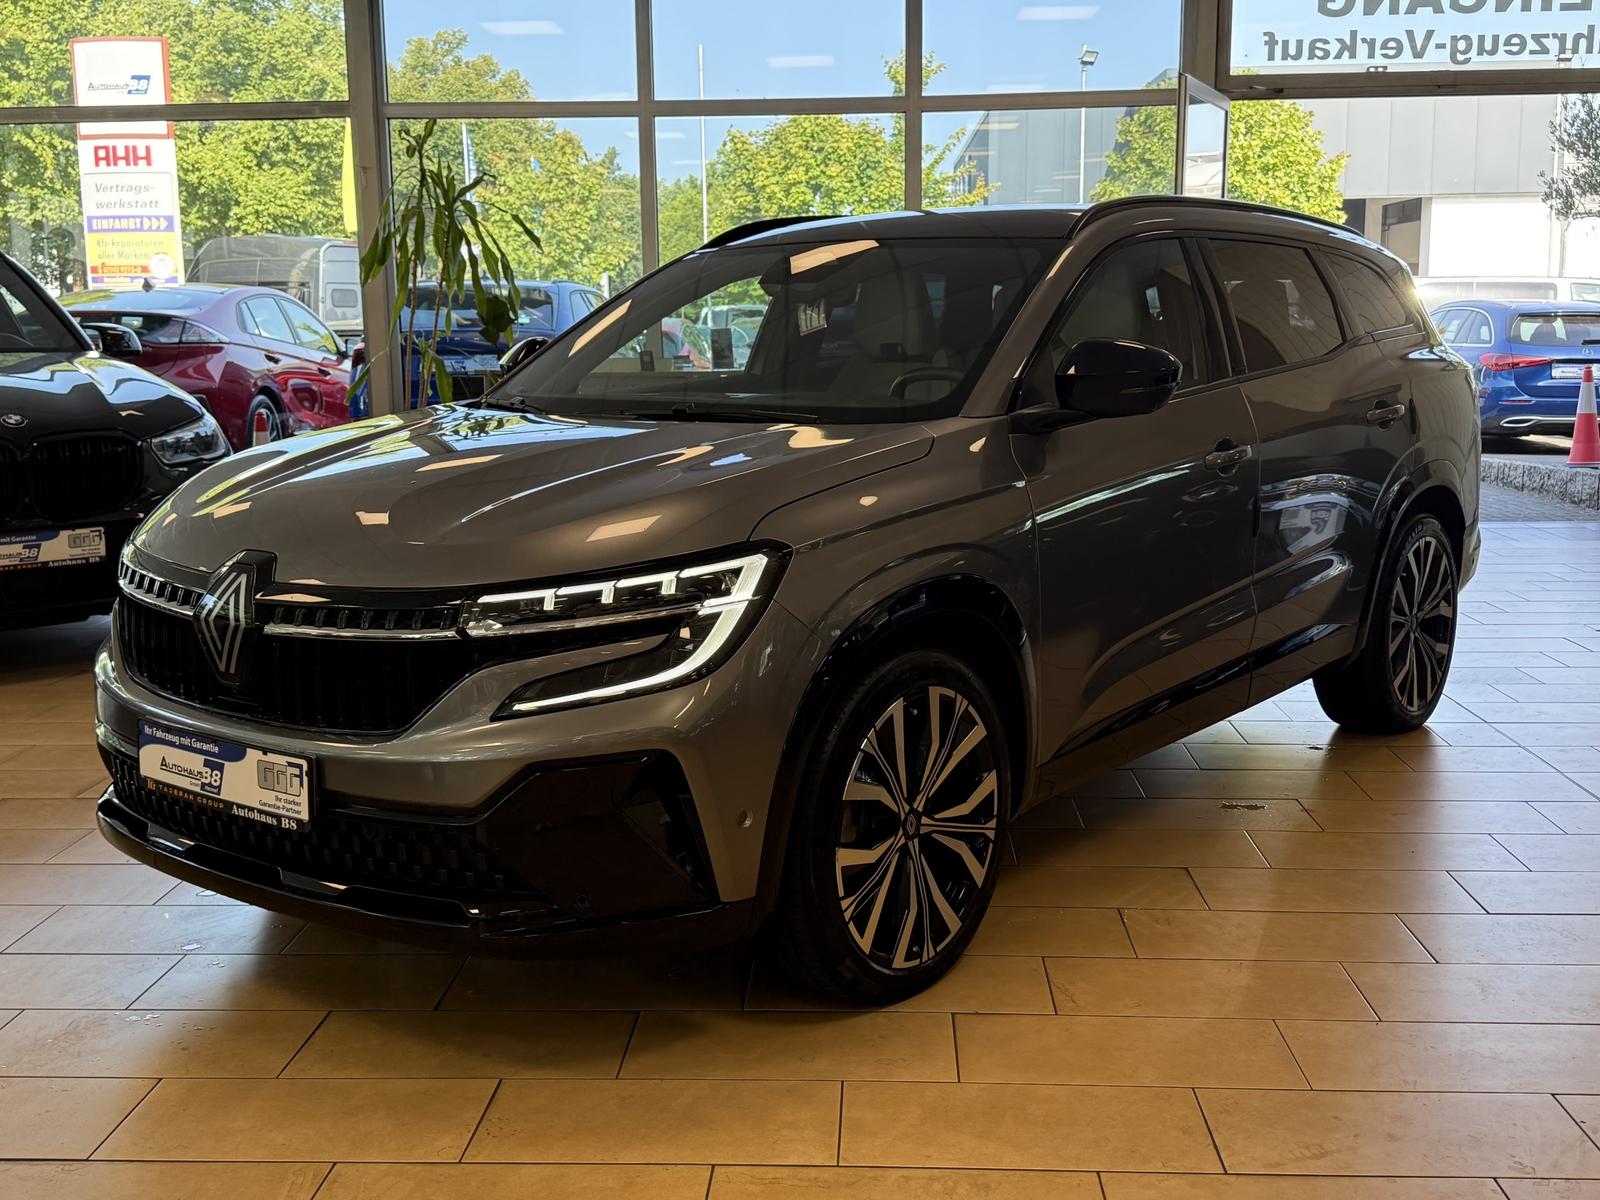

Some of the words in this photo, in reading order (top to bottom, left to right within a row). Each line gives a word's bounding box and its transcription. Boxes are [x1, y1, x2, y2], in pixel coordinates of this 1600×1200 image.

[94, 144, 152, 167] AHH
[94, 182, 156, 195] Vertrags-
[95, 198, 159, 209] werkstatt
[92, 217, 142, 230] EINFAHRT
[144, 724, 153, 736] Ihr
[153, 727, 180, 745] Fahrzeug
[180, 736, 191, 747] mit
[191, 738, 219, 754] Garantie
[160, 755, 204, 779] AUTOHAUS
[231, 804, 278, 826] Autohaus
